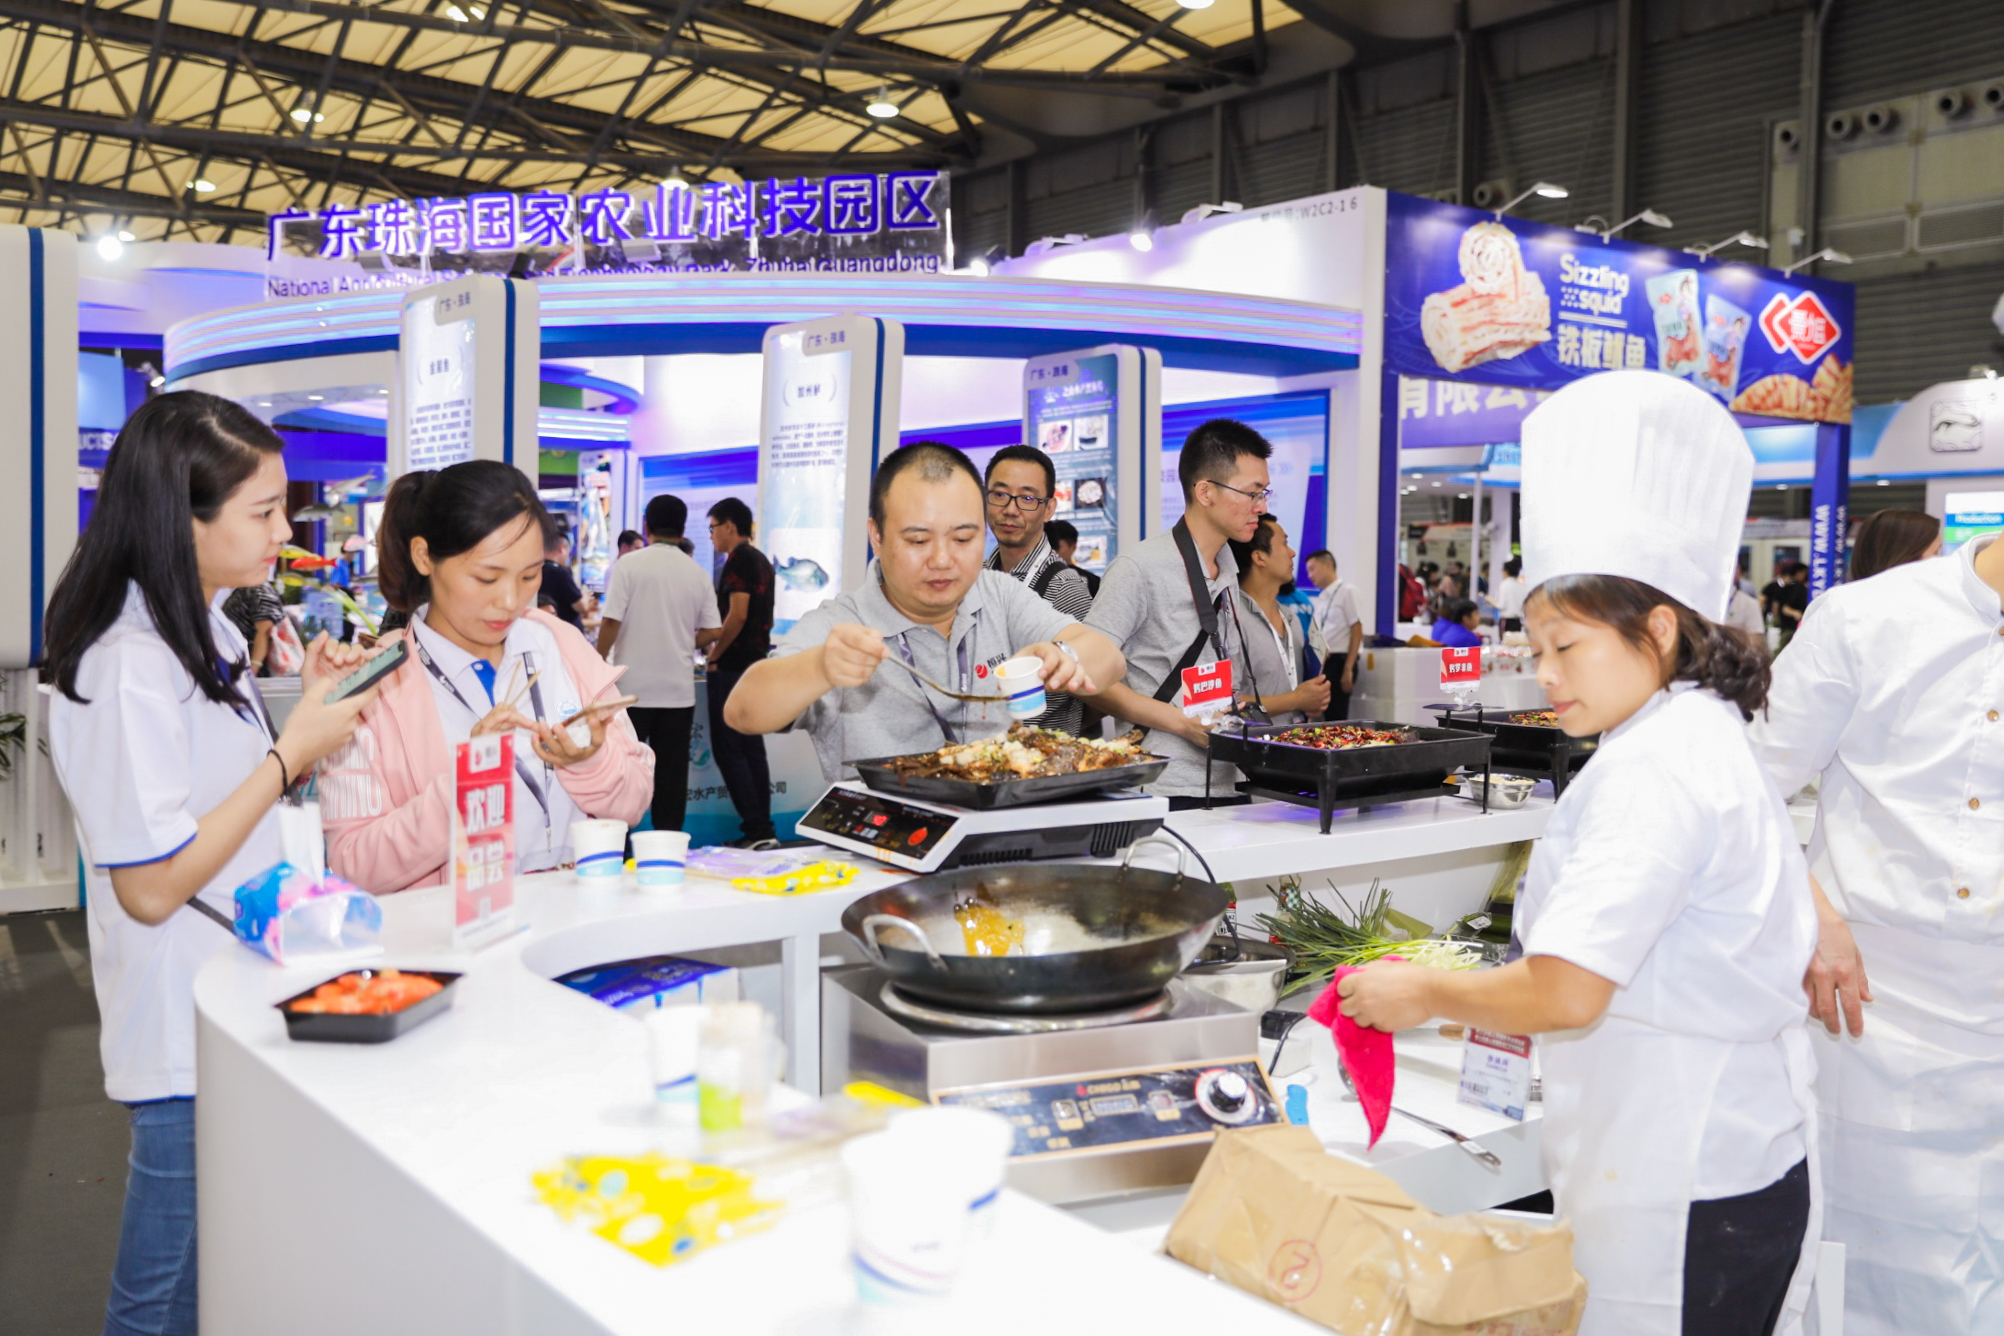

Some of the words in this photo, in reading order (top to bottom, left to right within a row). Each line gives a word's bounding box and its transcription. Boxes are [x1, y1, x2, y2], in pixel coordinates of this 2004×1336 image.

[267, 169, 942, 262] 广东珠海国家农业科技园区
[268, 278, 331, 298] National
[1559, 253, 1630, 298] Sizzling
[1578, 286, 1623, 316] squid
[1400, 376, 1552, 420] 有限公
[465, 783, 505, 835] 欢迎
[466, 839, 505, 892] 品尝
